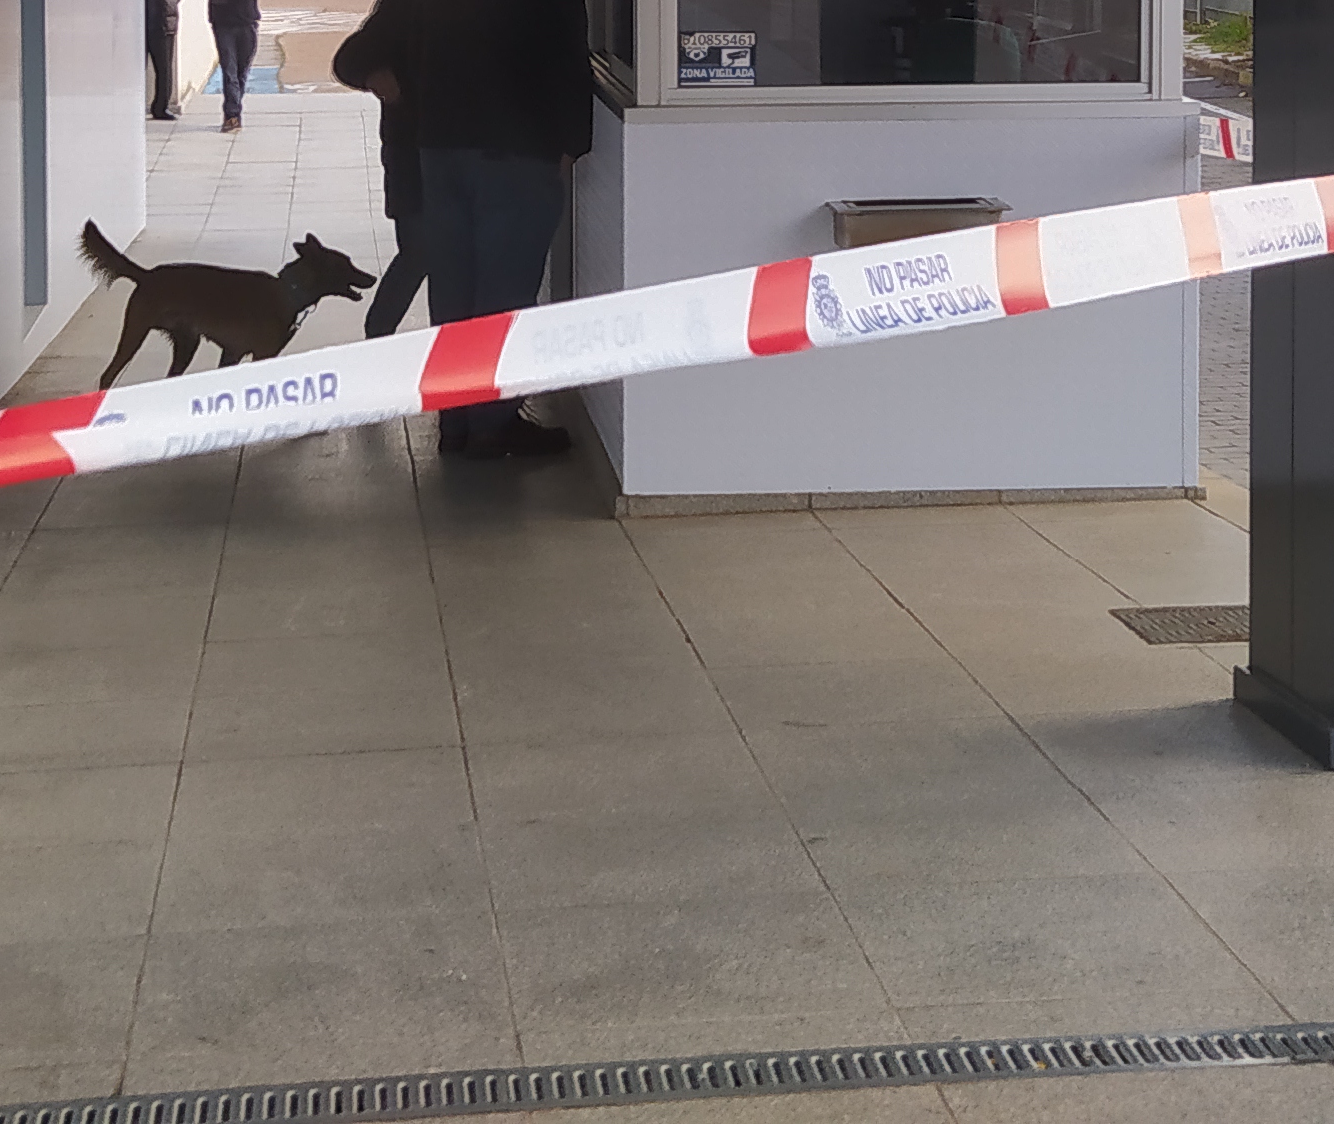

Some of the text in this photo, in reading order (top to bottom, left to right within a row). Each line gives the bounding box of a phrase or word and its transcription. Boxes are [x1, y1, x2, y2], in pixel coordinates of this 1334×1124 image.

[680, 67, 756, 78] ZONA VIGILADA
[864, 253, 953, 297] NO PASAR
[846, 284, 997, 334] LINEA DE POLICIA
